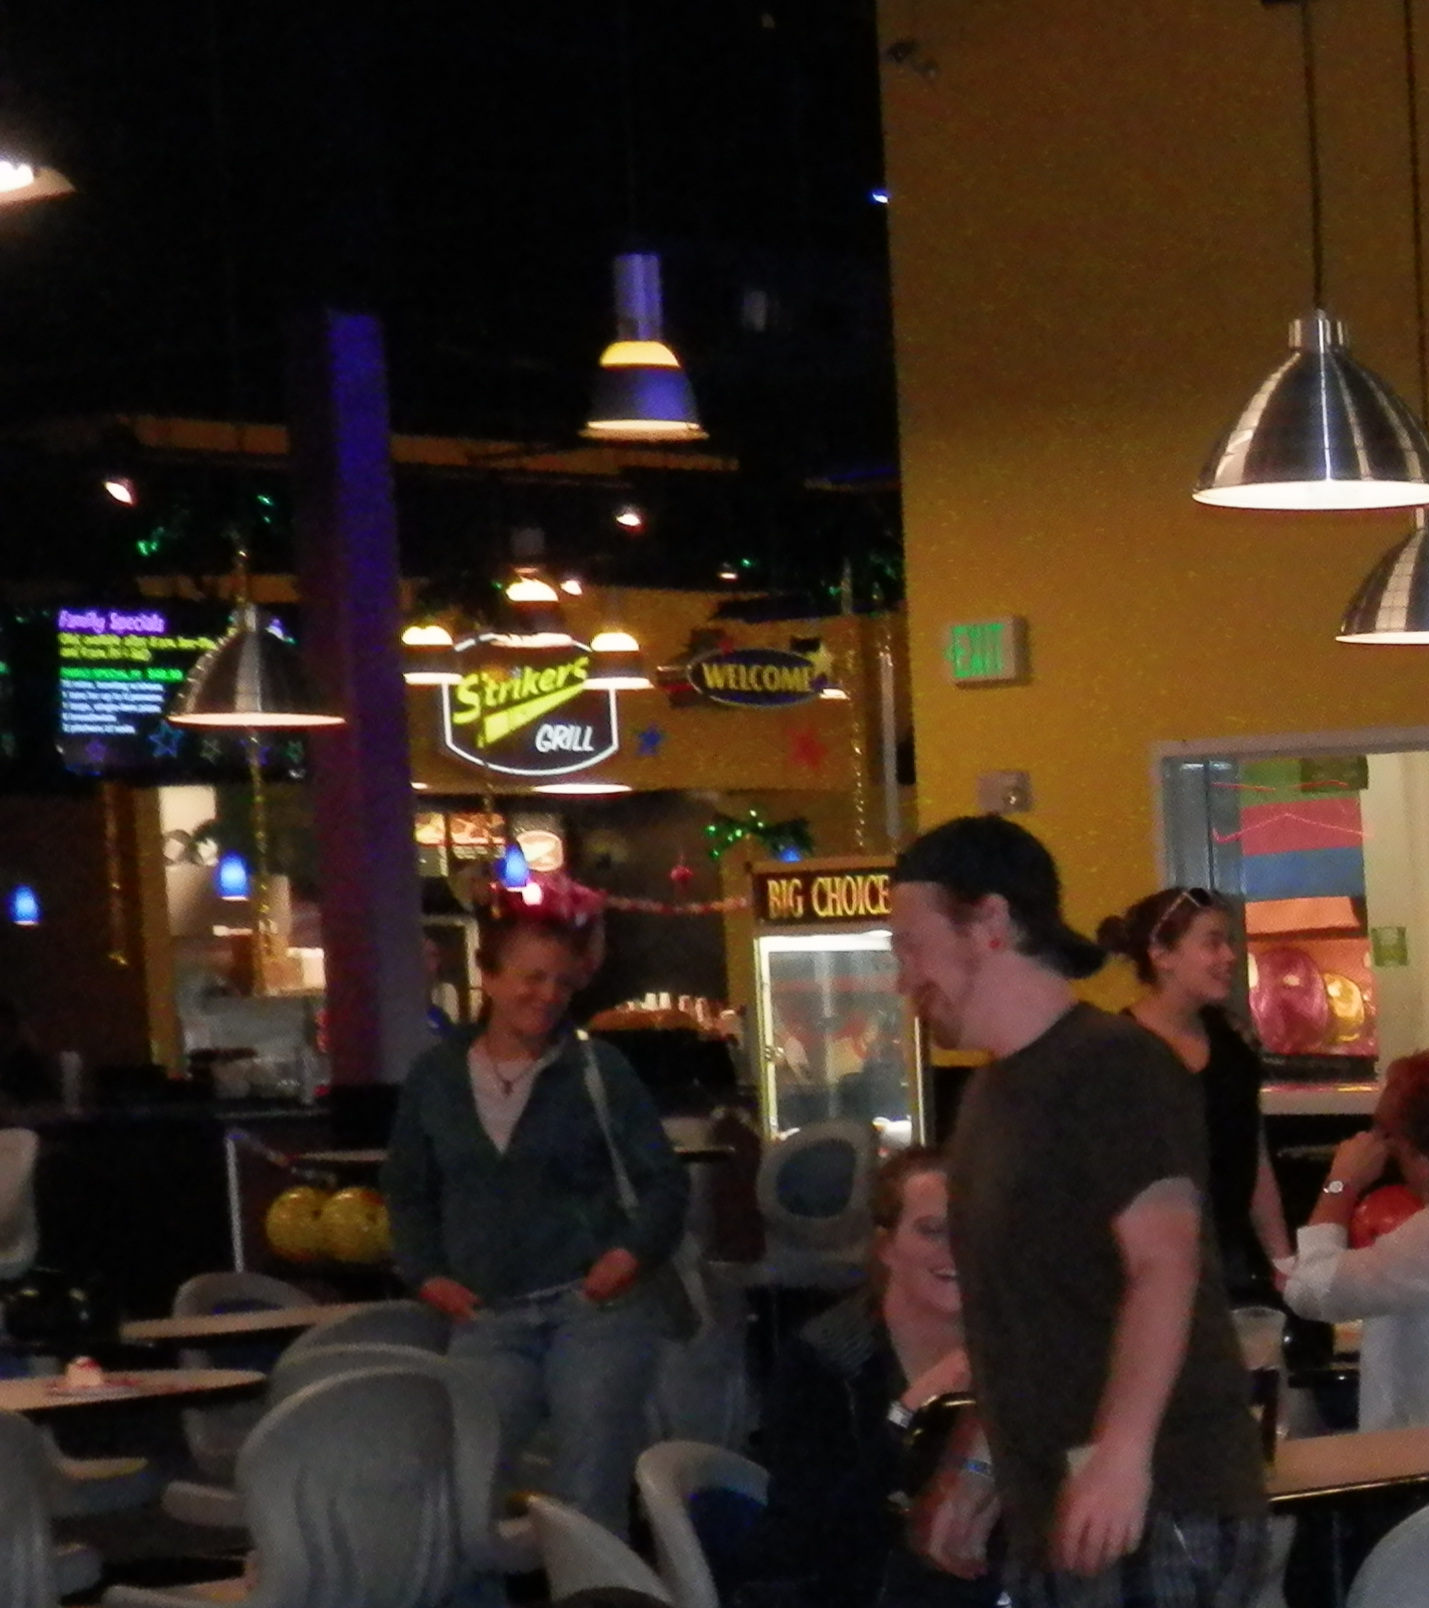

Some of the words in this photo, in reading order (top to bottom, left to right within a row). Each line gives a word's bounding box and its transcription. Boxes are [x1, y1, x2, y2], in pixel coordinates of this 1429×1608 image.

[452, 656, 589, 724] Strikers
[701, 662, 815, 692] WELCOME
[535, 723, 595, 753] GRILL
[767, 878, 803, 919] BIG
[811, 874, 892, 918] CHOICE
